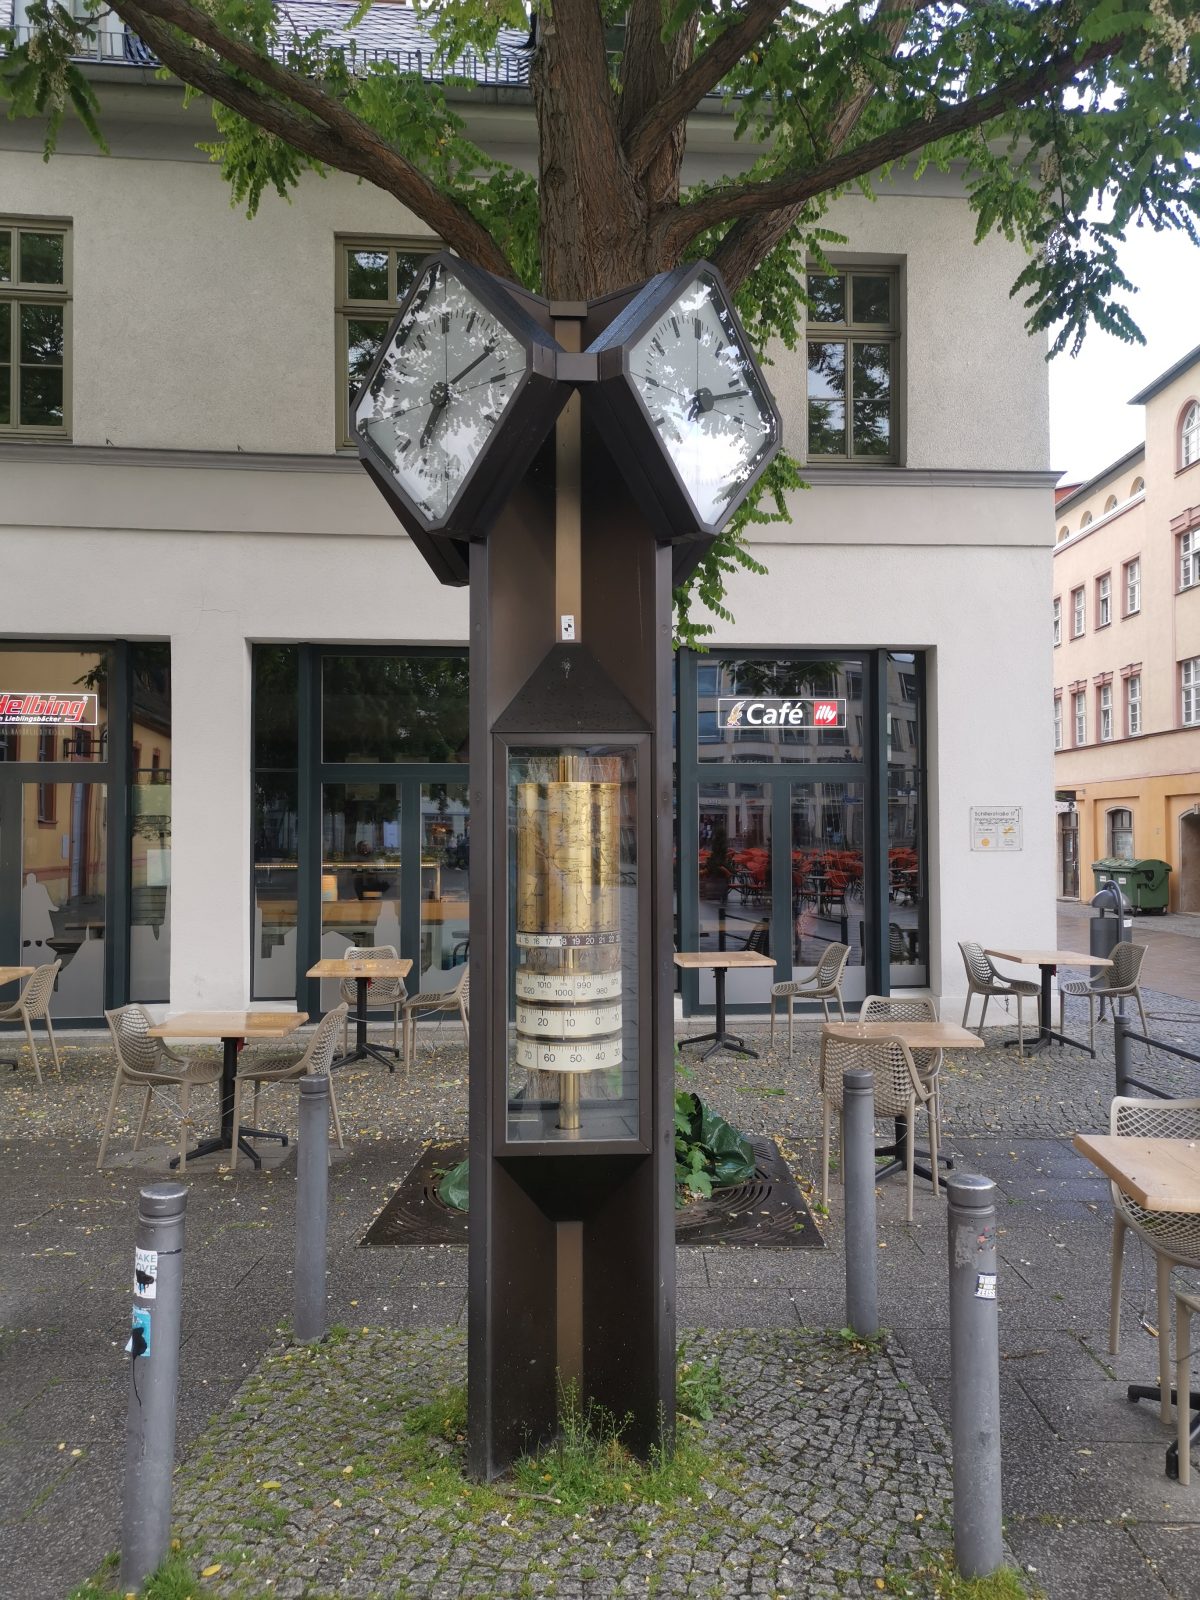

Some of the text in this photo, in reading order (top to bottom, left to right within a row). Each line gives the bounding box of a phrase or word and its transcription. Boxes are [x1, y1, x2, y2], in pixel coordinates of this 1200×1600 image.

[746, 702, 804, 725] Café
[815, 705, 837, 723] illy
[5, 715, 61, 723] Lieblingsbäcker
[572, 937, 581, 945] 19
[537, 981, 552, 989] 1010
[576, 981, 592, 989] 990
[555, 989, 573, 997] 1000
[537, 1017, 549, 1027] 20
[565, 1018, 575, 1027] 10
[524, 1050, 532, 1060] 70
[543, 1053, 556, 1063] 60
[569, 1053, 582, 1063] 50
[595, 1051, 606, 1061] 40
